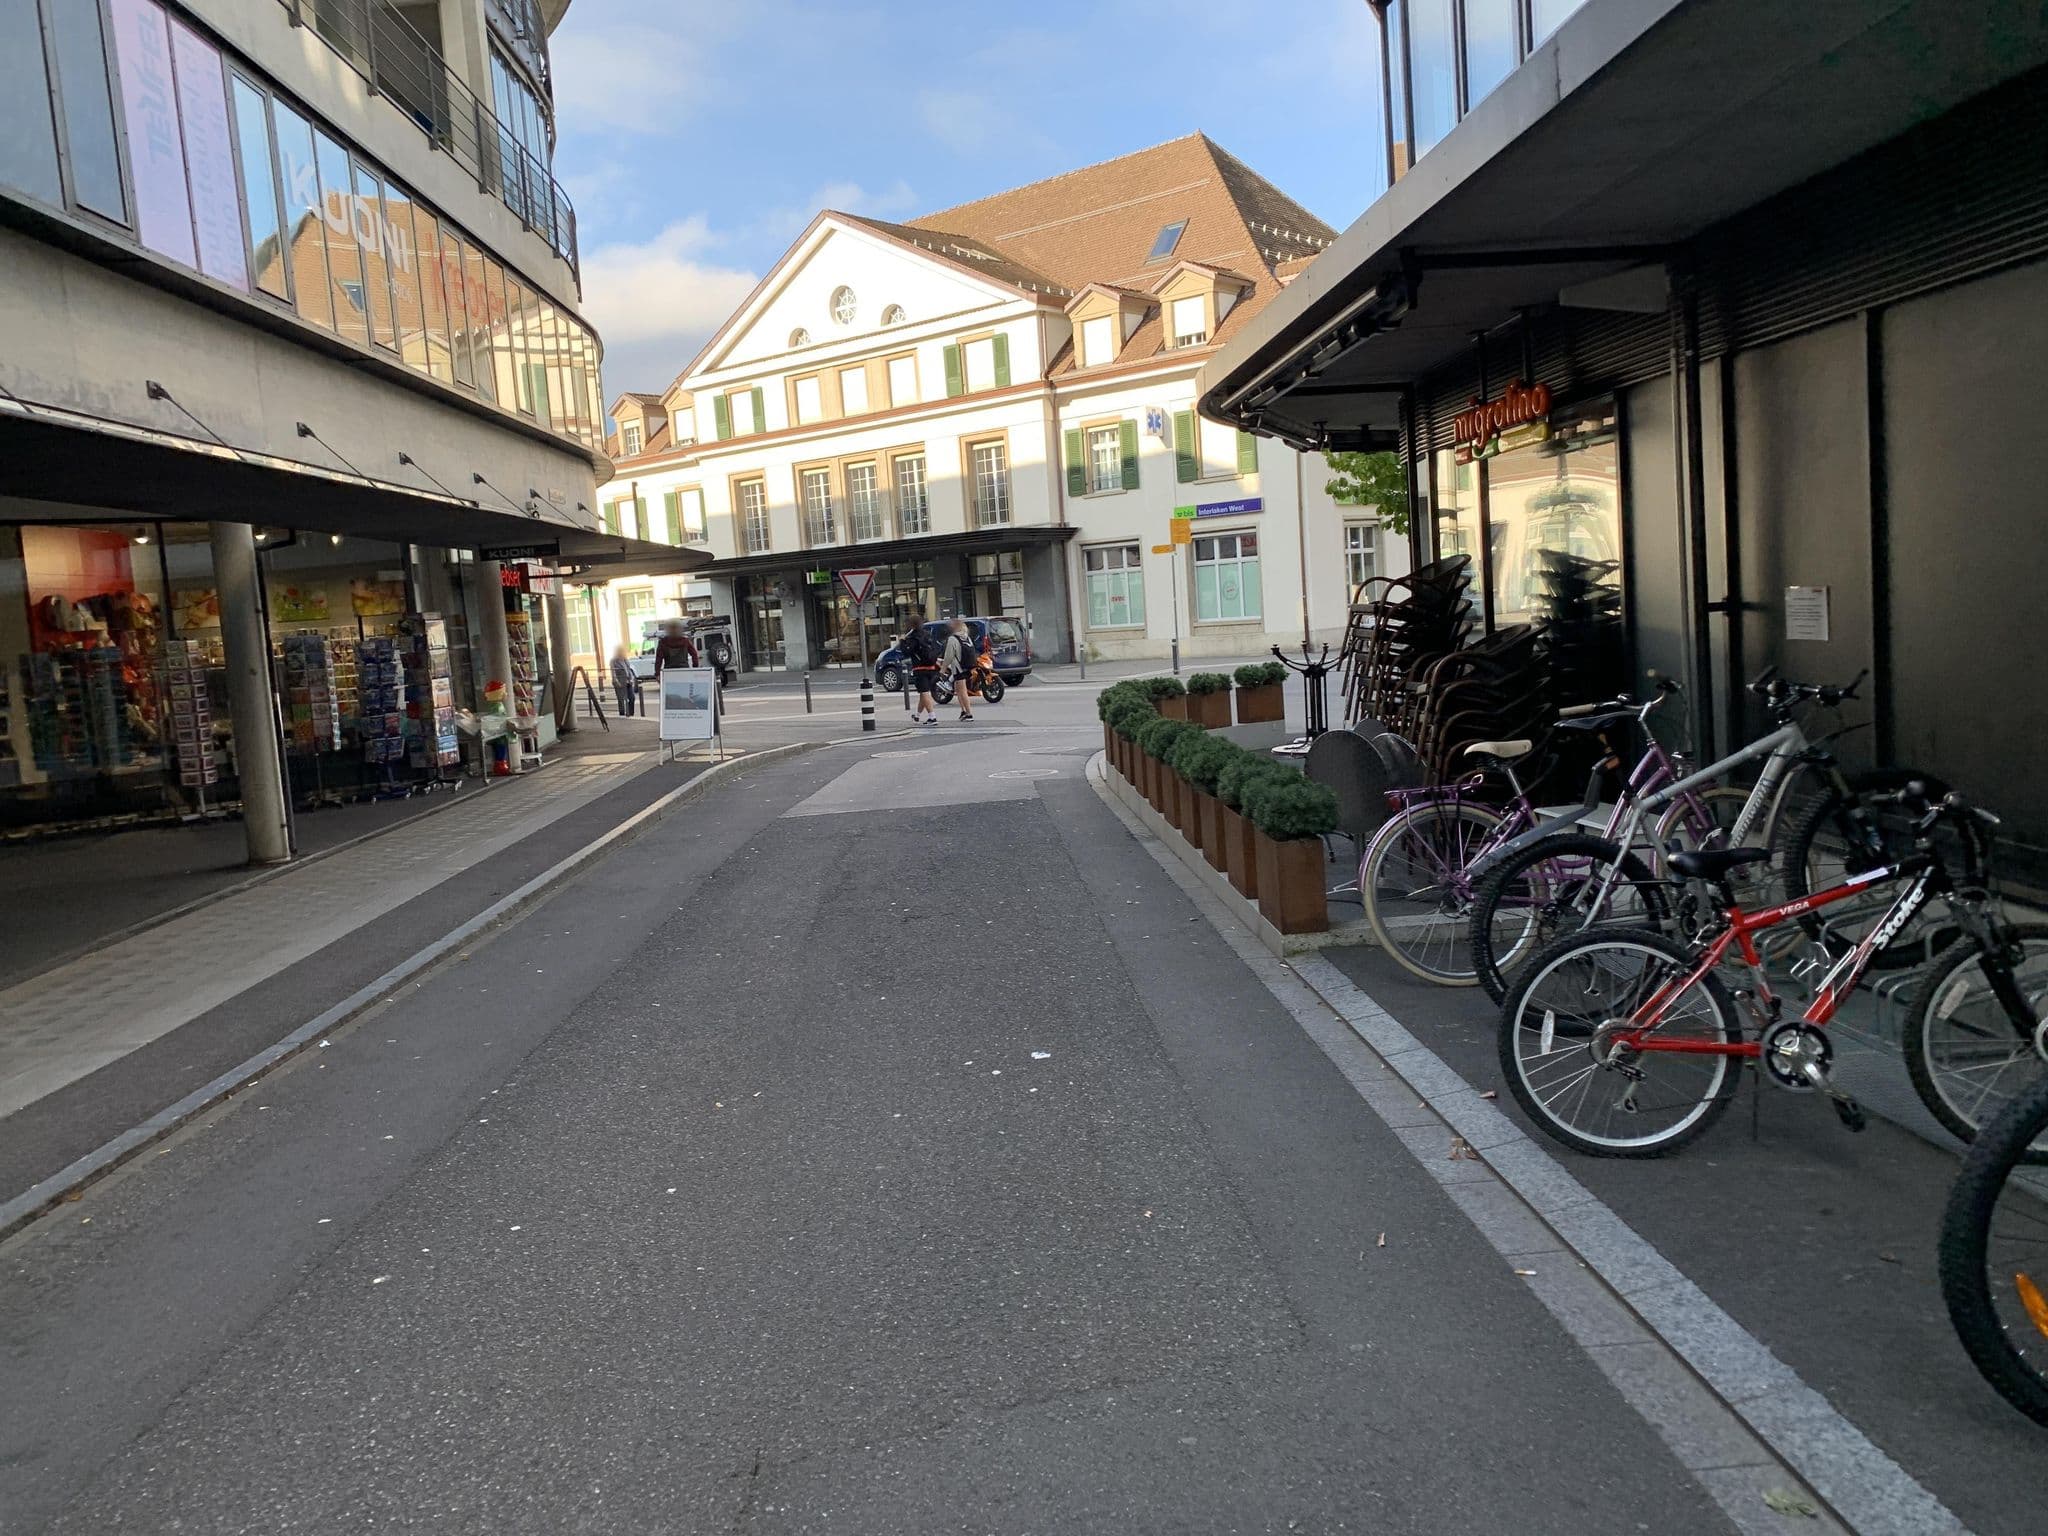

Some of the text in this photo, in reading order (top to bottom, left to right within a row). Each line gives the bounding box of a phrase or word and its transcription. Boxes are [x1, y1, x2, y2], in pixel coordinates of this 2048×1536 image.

[286, 151, 410, 274] KUONI
[1453, 380, 1551, 449] migrolino
[1198, 504, 1244, 515] Interlaken West
[488, 548, 535, 558] KUONI
[1779, 901, 1810, 916] VEGA
[1871, 887, 1924, 950] Stoke
